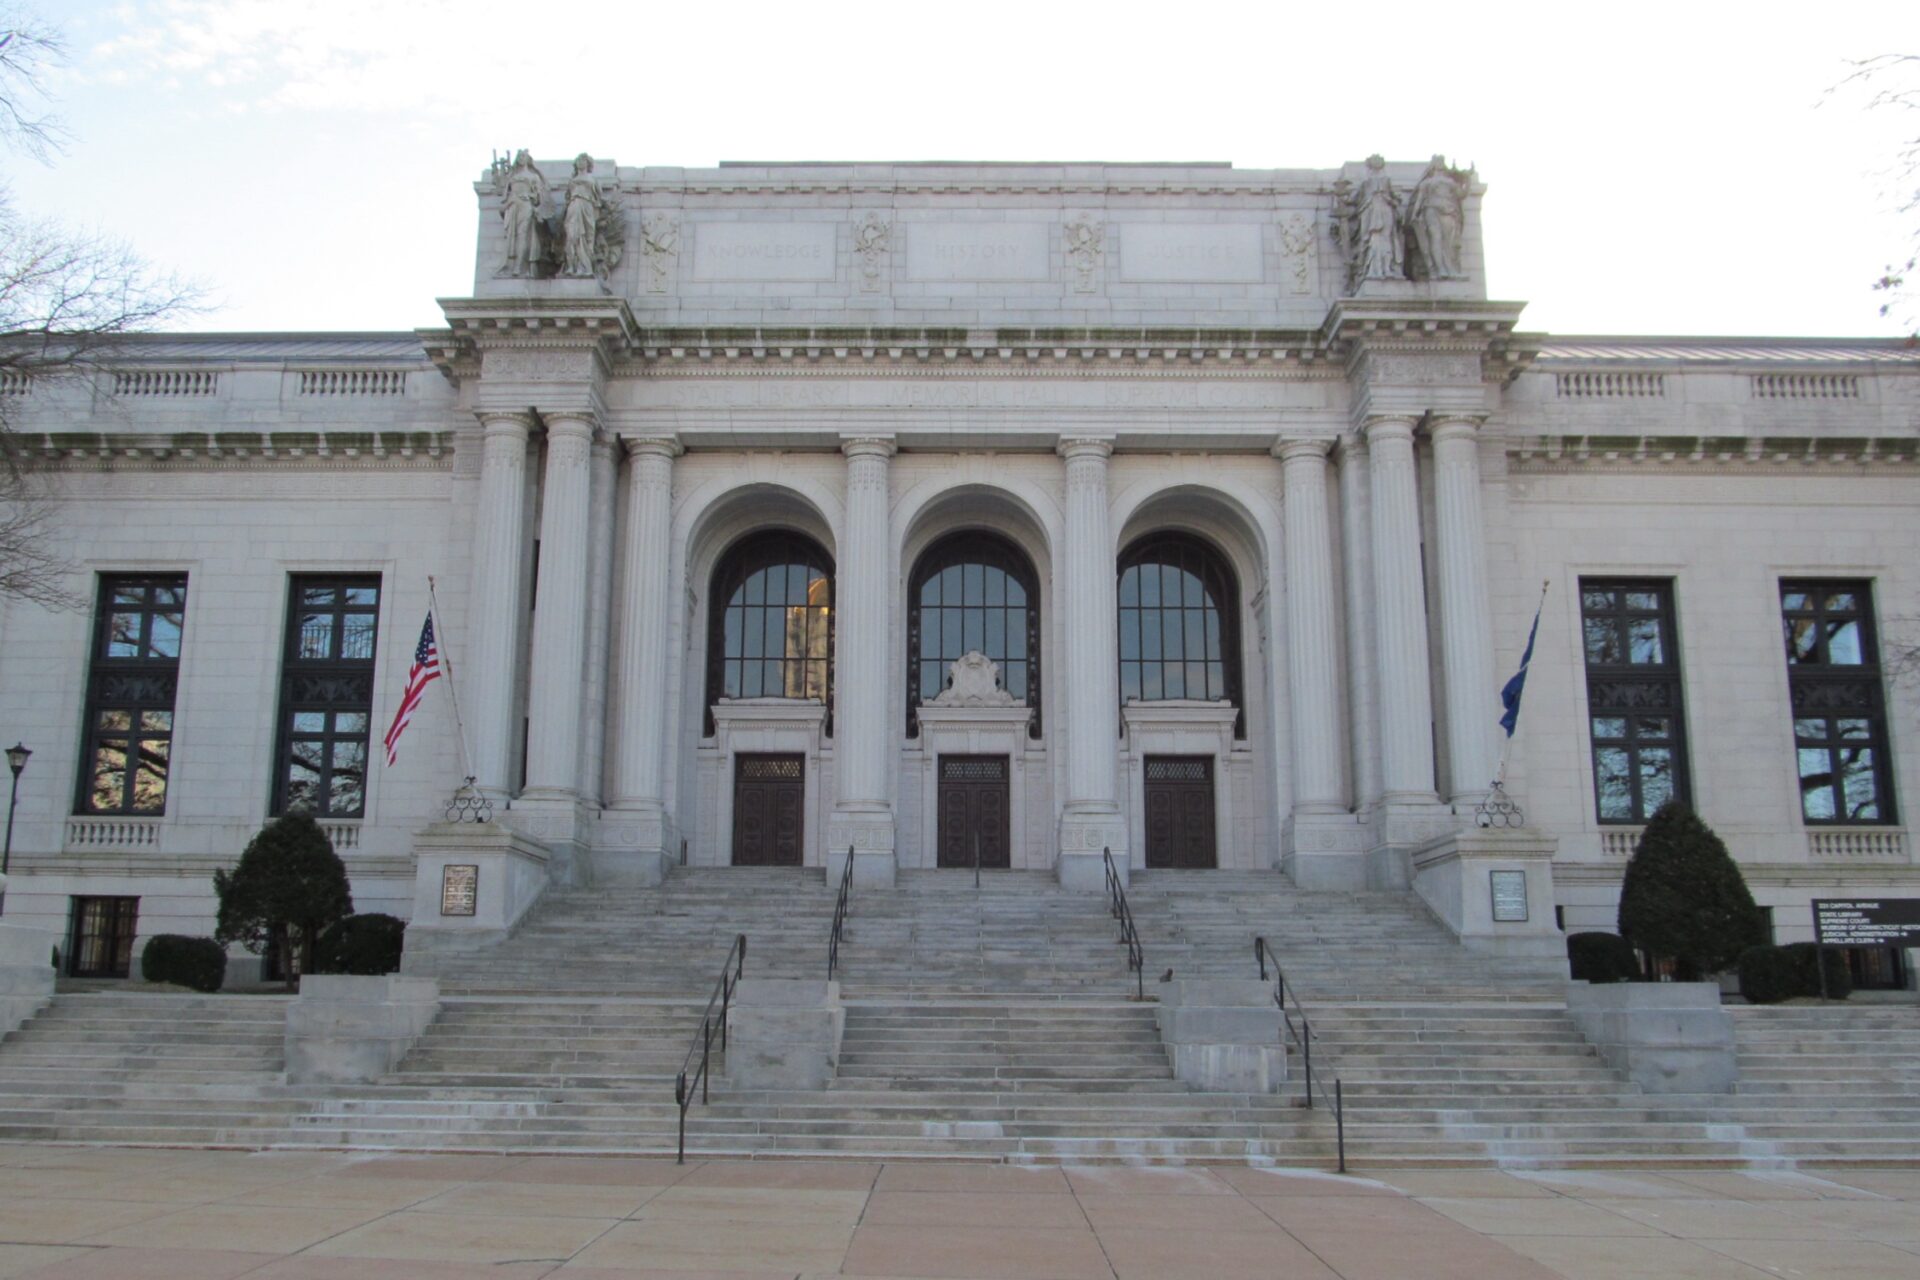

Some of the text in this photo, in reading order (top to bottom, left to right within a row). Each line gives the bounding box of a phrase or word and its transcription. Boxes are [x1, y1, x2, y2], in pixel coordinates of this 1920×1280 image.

[707, 245, 822, 258] KNOWLEDGE
[935, 244, 1020, 258] HISTORY
[1149, 245, 1236, 258] JUSTICE
[672, 385, 841, 404] STATE LIBRARY
[892, 385, 1066, 404] MEMORIAL HALL
[1106, 386, 1283, 405] SUPREME COURT
